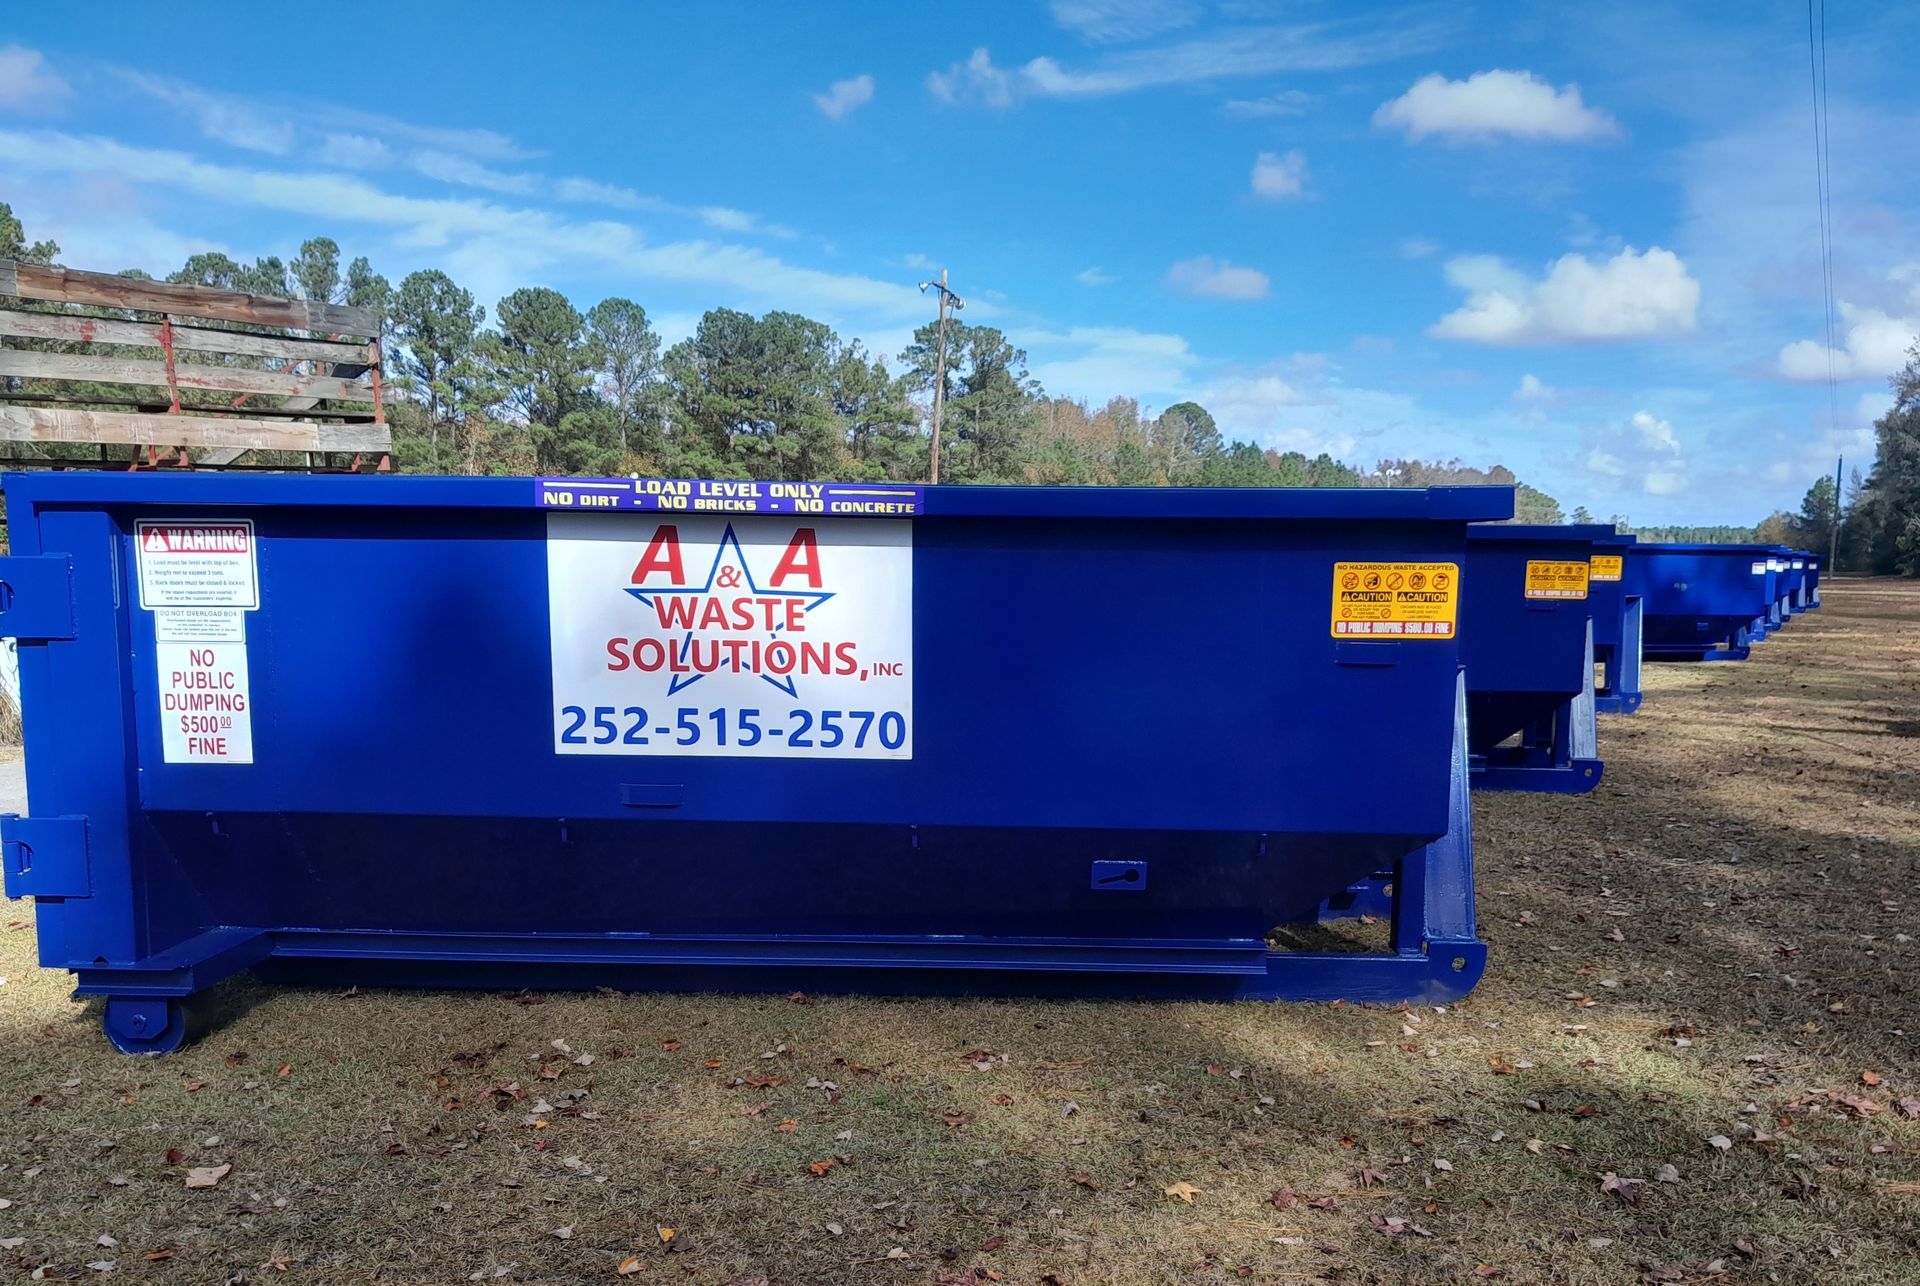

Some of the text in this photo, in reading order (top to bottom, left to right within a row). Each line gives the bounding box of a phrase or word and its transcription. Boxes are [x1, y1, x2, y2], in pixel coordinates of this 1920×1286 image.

[635, 480, 824, 498] LOAD LEVEL ONLY
[543, 492, 573, 505] NO
[580, 495, 620, 506] DIRT
[658, 496, 688, 509] NO
[694, 499, 757, 511] BRICKS
[794, 499, 824, 512] NO
[830, 501, 915, 513] CONCRETE
[167, 529, 247, 551] WARNING
[631, 524, 823, 588] A & A
[1351, 592, 1448, 602] CAUTION CAUTION
[653, 595, 806, 632] WASTE
[190, 649, 215, 667] NO
[607, 637, 904, 681] SOLUTIONS, INC
[172, 671, 235, 690] PUBLIC
[164, 693, 245, 712] DUMPING
[561, 705, 906, 750] 252-515-2570
[189, 737, 227, 755] FINE
